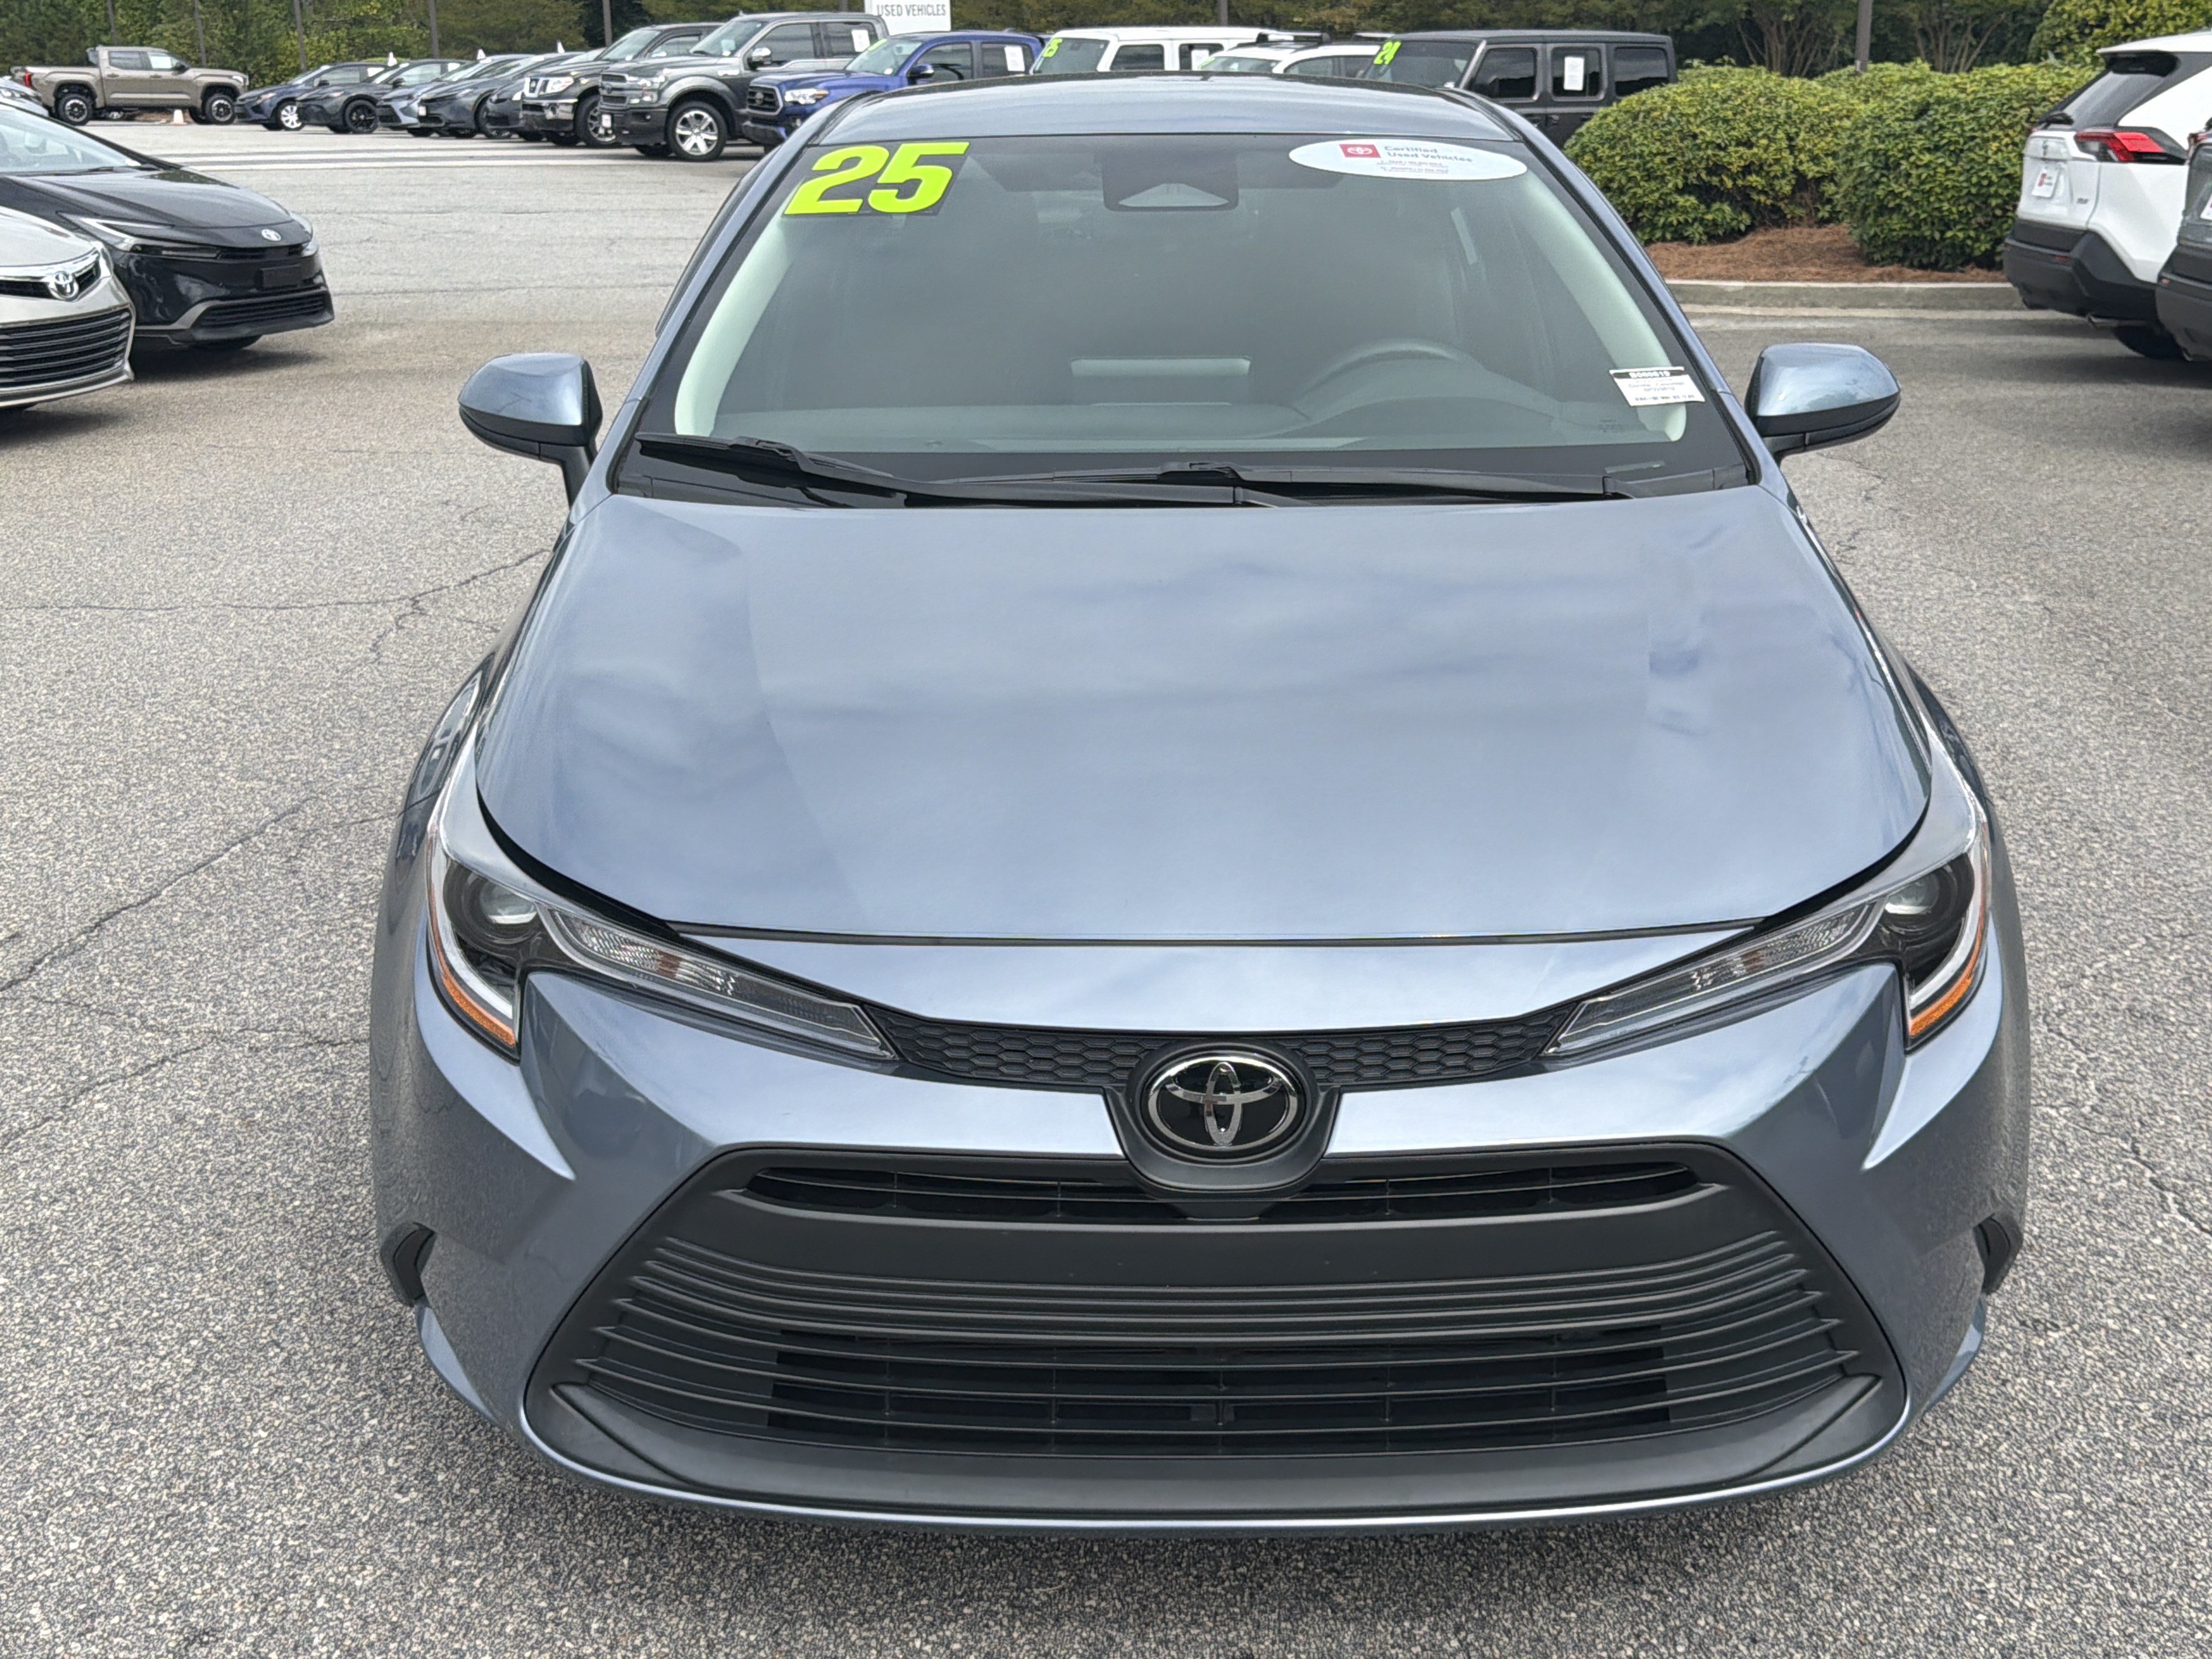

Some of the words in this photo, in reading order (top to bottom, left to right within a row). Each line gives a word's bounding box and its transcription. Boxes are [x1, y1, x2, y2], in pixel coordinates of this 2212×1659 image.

[876, 4, 903, 16] USED
[905, 4, 946, 16] VEHICLES
[1373, 41, 1402, 65] 24
[1421, 153, 1473, 162] Vehicles
[783, 142, 970, 215] 25
